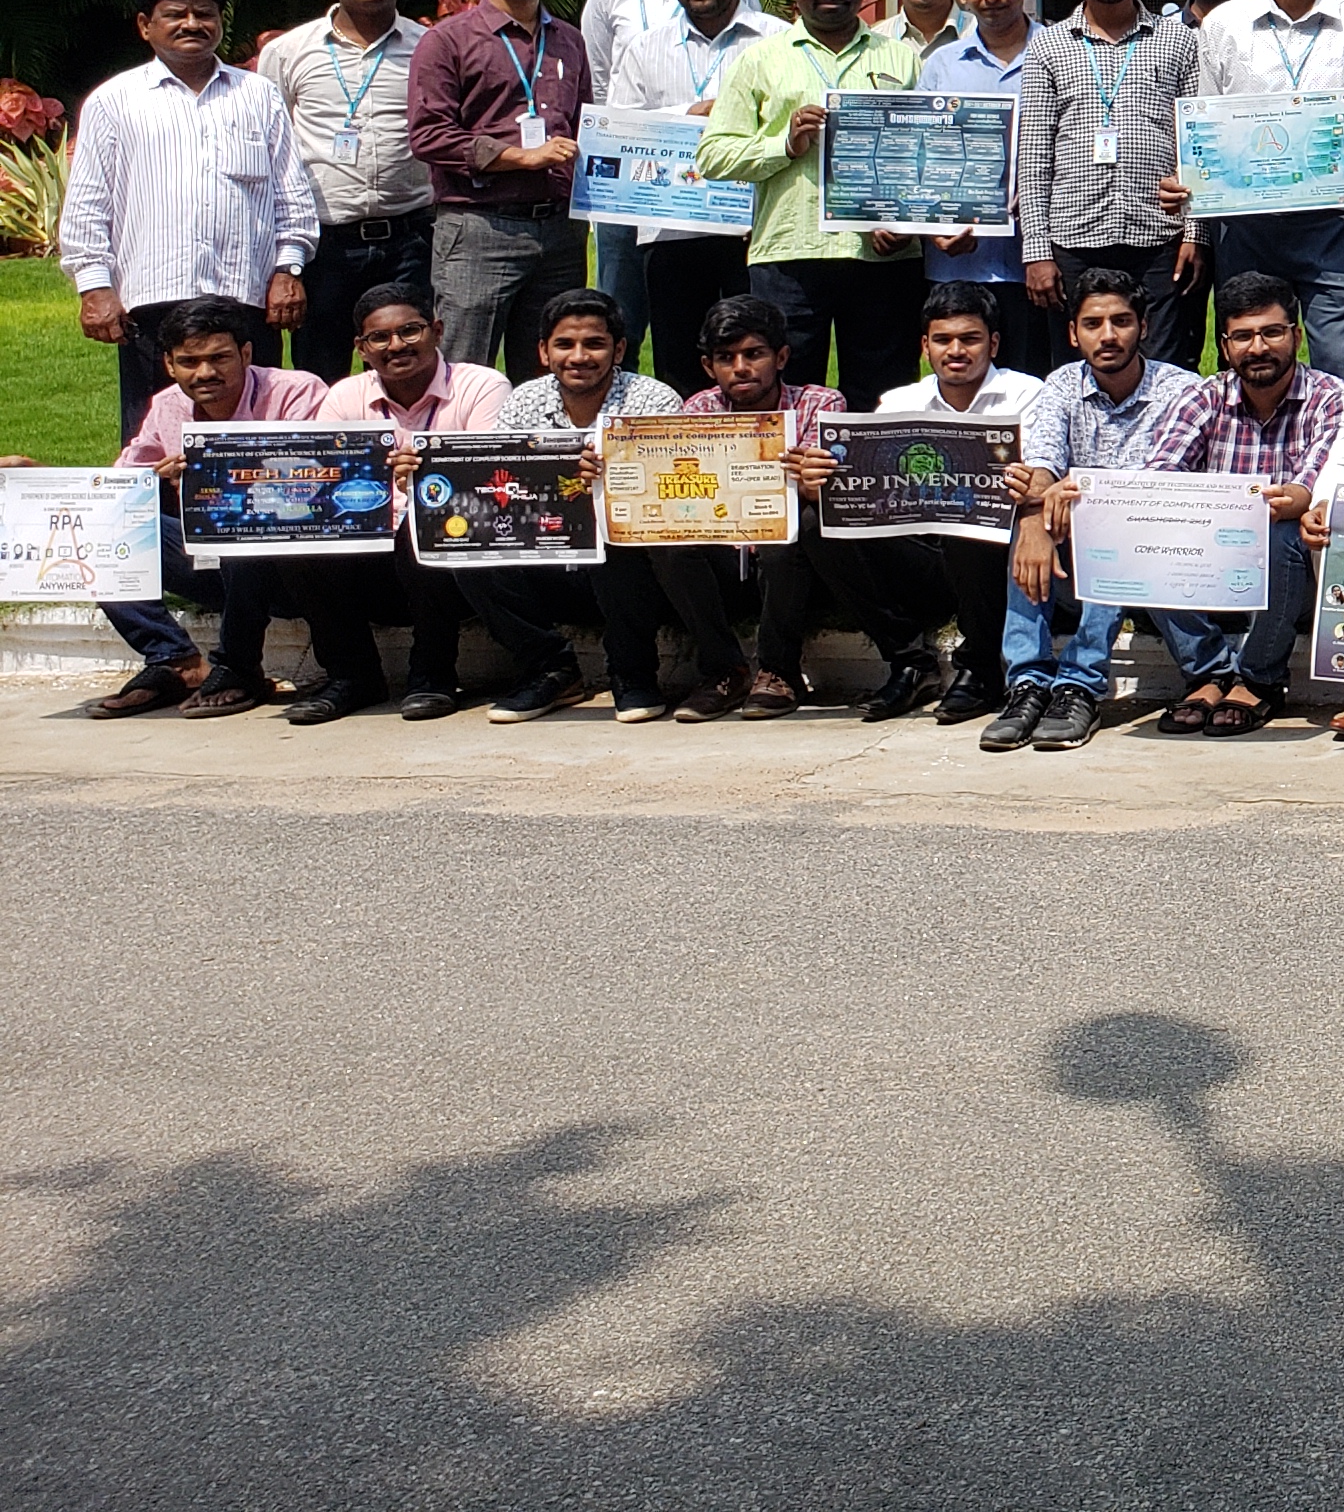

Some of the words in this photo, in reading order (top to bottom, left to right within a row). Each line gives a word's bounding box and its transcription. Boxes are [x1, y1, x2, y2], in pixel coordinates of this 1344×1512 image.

[620, 145, 657, 157] BATTLE
[661, 149, 674, 158] OF
[607, 433, 670, 442] Department
[686, 433, 736, 441] computer
[229, 468, 279, 480] TECH
[288, 467, 342, 479] MAZE
[658, 473, 718, 485] TREASURE
[830, 476, 876, 491] APP
[883, 473, 1009, 489] INVENTOR
[658, 483, 720, 499] HUNT
[918, 498, 965, 507] Participation
[1086, 498, 1149, 507] DEPARTMENT
[1162, 500, 1213, 509] COMPUTER
[1213, 502, 1253, 511] SCIENCE
[49, 514, 84, 531] RPA
[1134, 544, 1160, 555] CODE
[1161, 545, 1204, 557] WARRIOR
[39, 581, 87, 591] ANYWHERE
